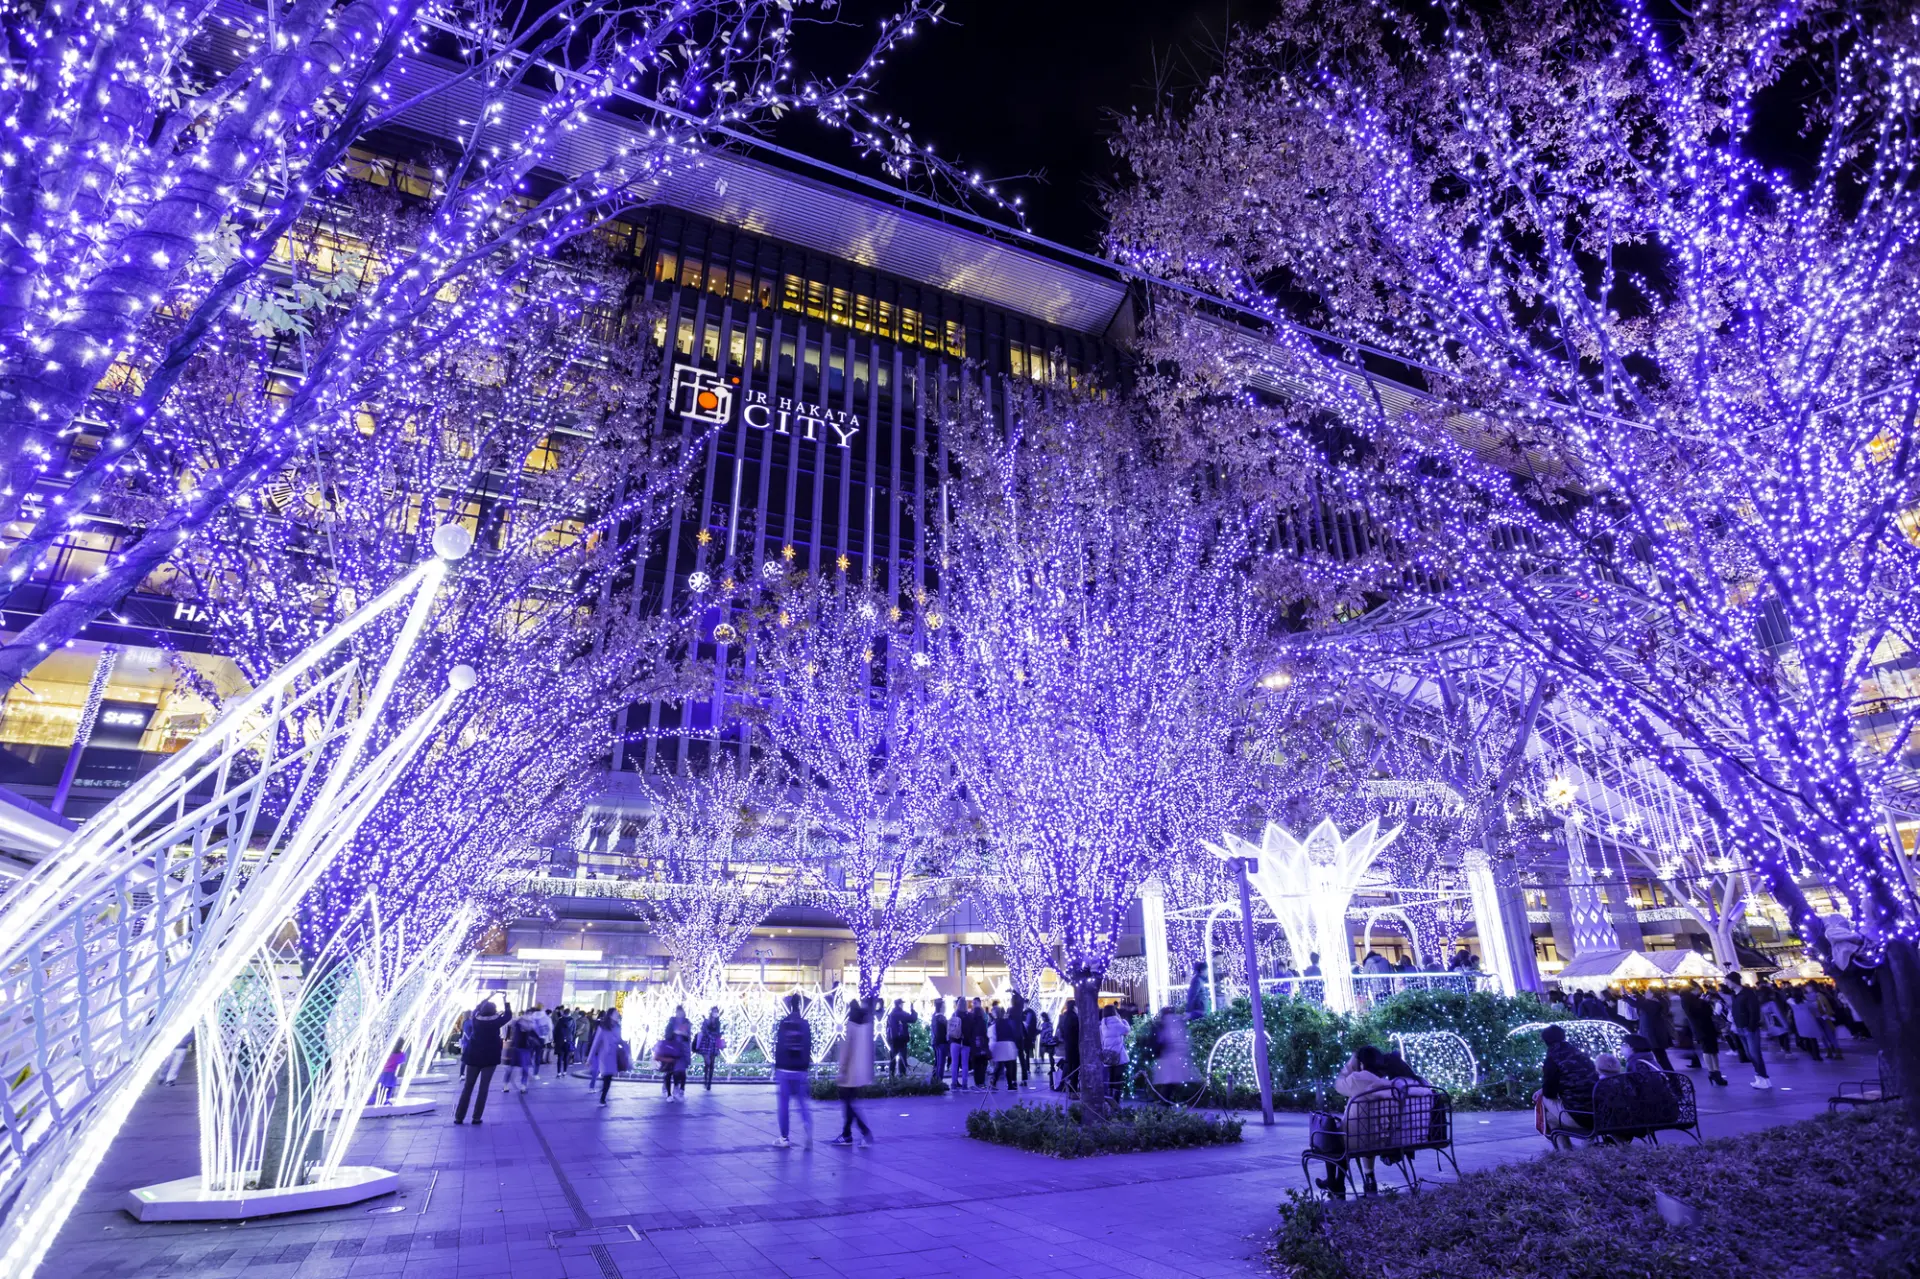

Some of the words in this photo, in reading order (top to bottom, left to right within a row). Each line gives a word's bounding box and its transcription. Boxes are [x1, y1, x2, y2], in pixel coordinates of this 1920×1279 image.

[743, 404, 860, 448] CITY
[746, 389, 767, 404] JR
[780, 397, 860, 427] HAKATA
[102, 710, 144, 726] SHIPS
